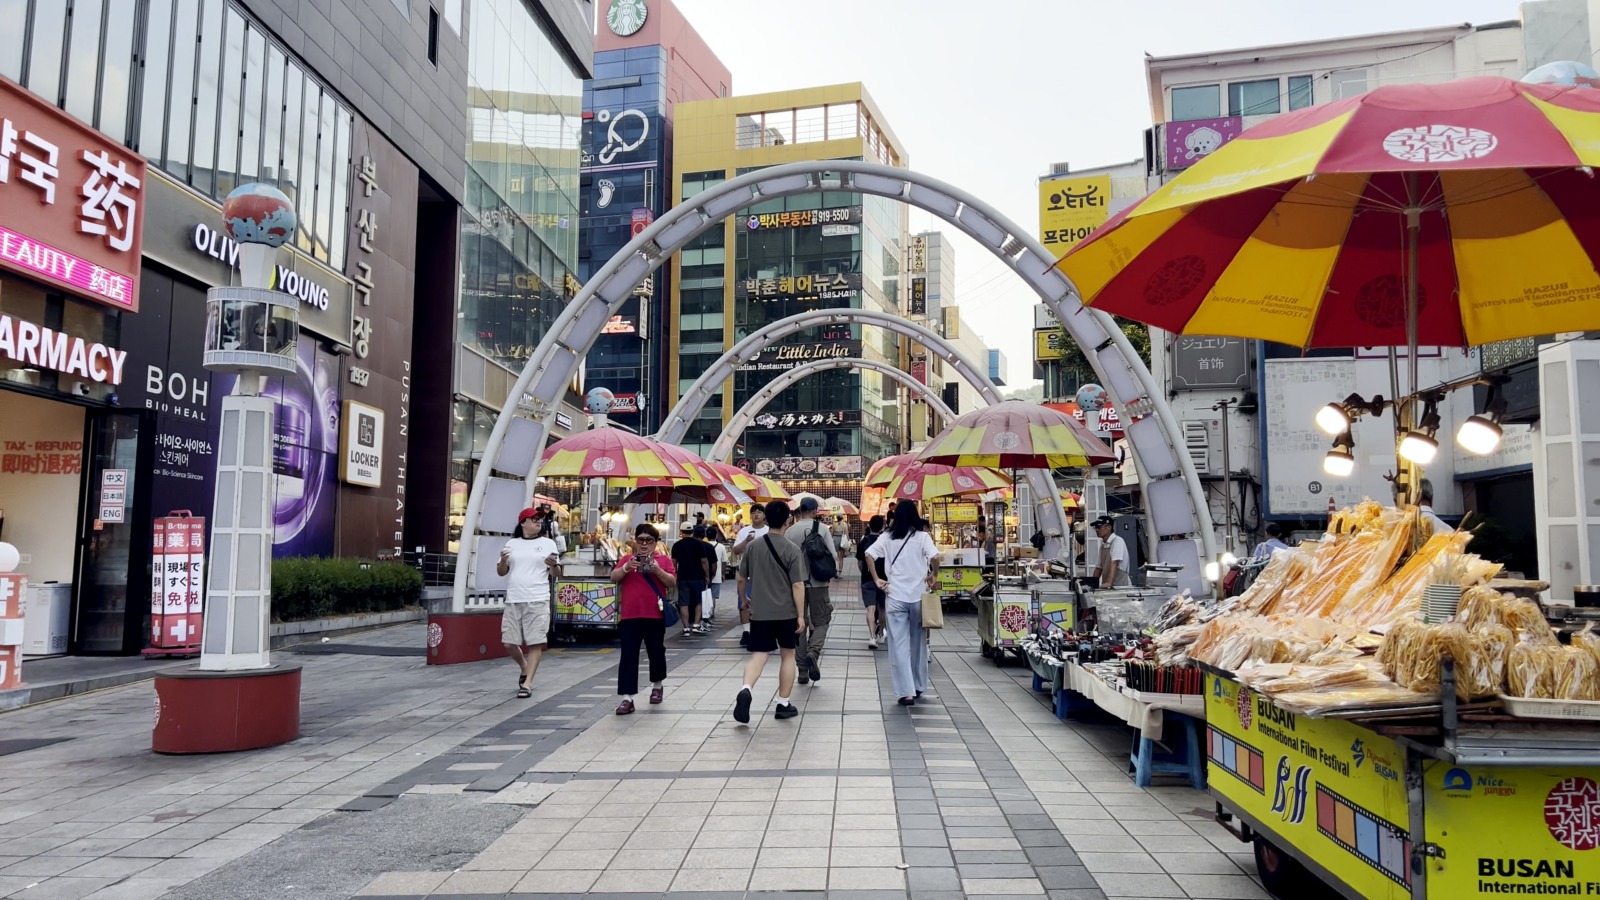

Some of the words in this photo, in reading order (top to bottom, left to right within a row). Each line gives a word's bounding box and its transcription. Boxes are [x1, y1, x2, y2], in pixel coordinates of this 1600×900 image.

[78, 150, 140, 253] 药
[818, 208, 849, 223] 919-5500
[1044, 224, 1097, 245] 프라이
[194, 223, 241, 270] OLIV
[277, 264, 329, 311] YOUNG
[353, 155, 379, 360] 부산극장
[90, 265, 125, 301] 药店
[776, 344, 811, 360] Little
[812, 343, 849, 358] India
[1181, 336, 1239, 351] ジュエリー
[757, 361, 793, 371] Restaurant
[1198, 357, 1224, 370] 首饰
[146, 365, 208, 406] BOH
[350, 366, 370, 387] 1937
[399, 360, 410, 436] PUSAN
[145, 399, 169, 412] BIO
[174, 405, 206, 421] HEAL
[778, 412, 841, 427] 汤火功夫
[4, 440, 26, 451] TAX
[35, 440, 82, 451] REFUND
[1, 453, 82, 475] 即时退税
[159, 450, 189, 467] 스킨케어
[350, 450, 379, 469] LOCKER
[106, 473, 123, 483] 中文
[103, 509, 121, 518] ENG
[393, 452, 407, 557] THEATER
[167, 561, 200, 573] 現場で
[168, 576, 199, 588] すぐに
[167, 590, 199, 607] 免税
[1257, 698, 1296, 731] BUSAN
[1257, 719, 1299, 752] International
[1300, 738, 1318, 760] Film
[1319, 748, 1350, 777] Festival
[1374, 762, 1399, 782] BUSAN
[1477, 775, 1504, 787] Nice
[1478, 858, 1574, 879] BUSAN
[1478, 880, 1581, 895] International
